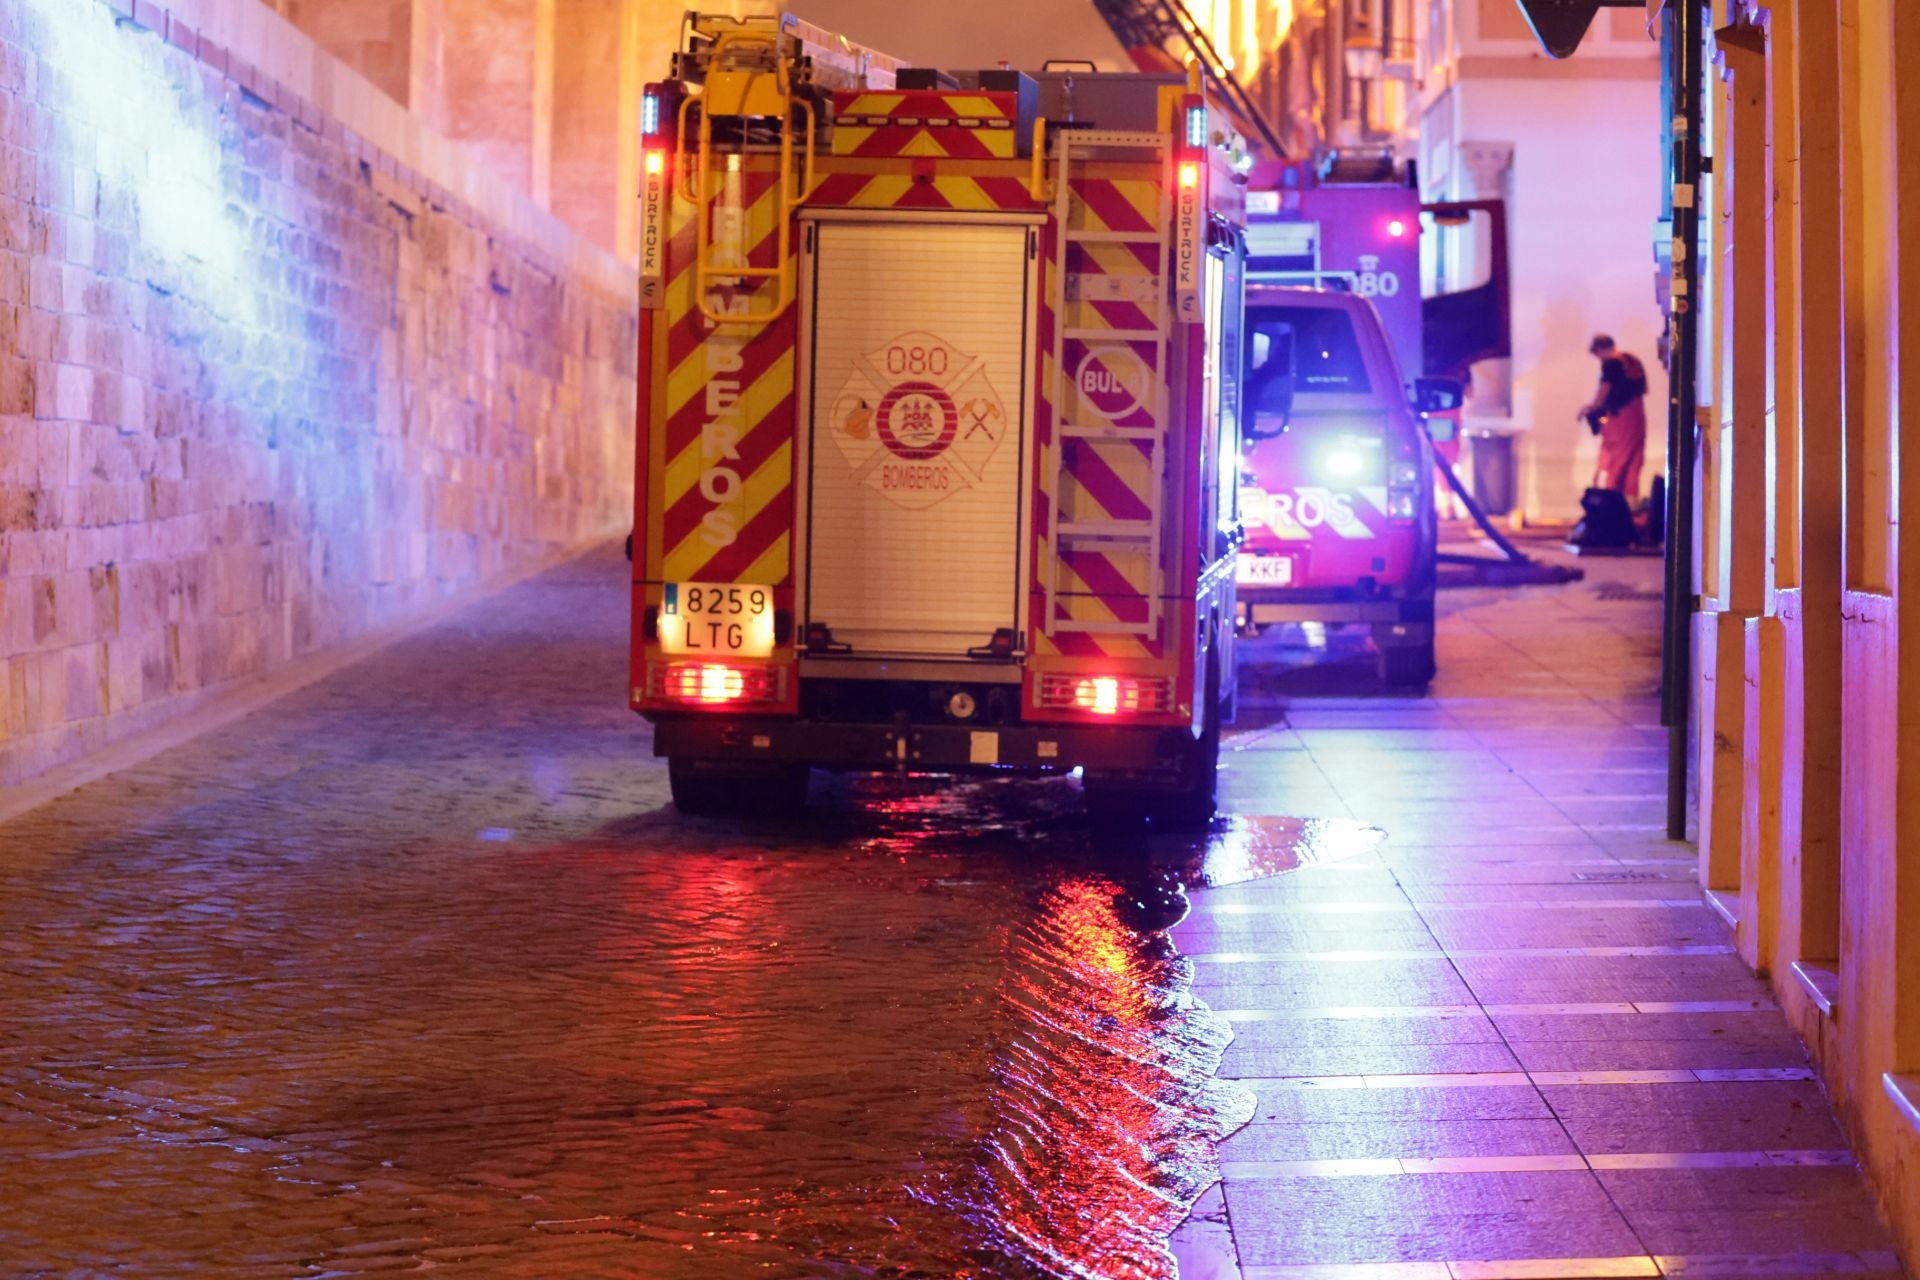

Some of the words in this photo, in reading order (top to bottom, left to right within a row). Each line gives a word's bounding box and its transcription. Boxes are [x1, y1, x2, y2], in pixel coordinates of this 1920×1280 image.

[887, 346, 948, 375] 080
[882, 465, 949, 489] BOMBEROS
[1250, 561, 1285, 578] KKF
[687, 588, 765, 614] 8259
[686, 621, 743, 649] LTG
